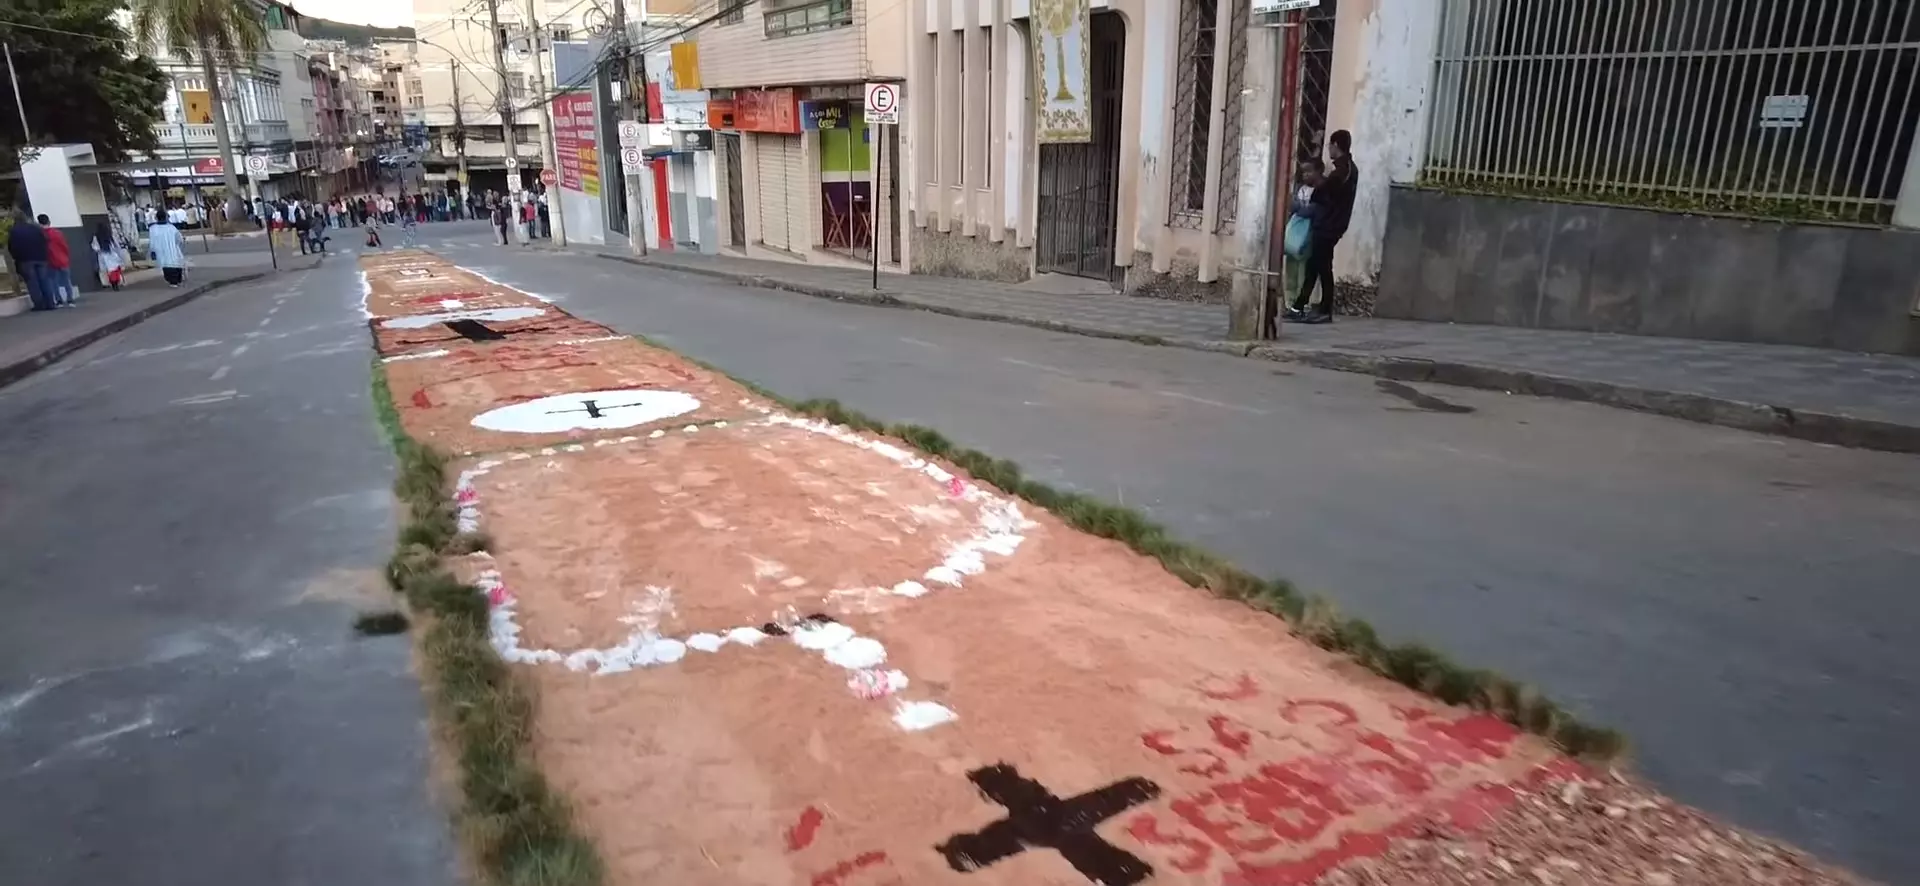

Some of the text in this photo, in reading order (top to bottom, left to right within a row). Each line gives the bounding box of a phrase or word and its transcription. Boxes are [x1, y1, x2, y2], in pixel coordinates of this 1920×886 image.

[877, 90, 888, 107] E
[826, 106, 842, 118] MIL
[628, 152, 636, 162] E
